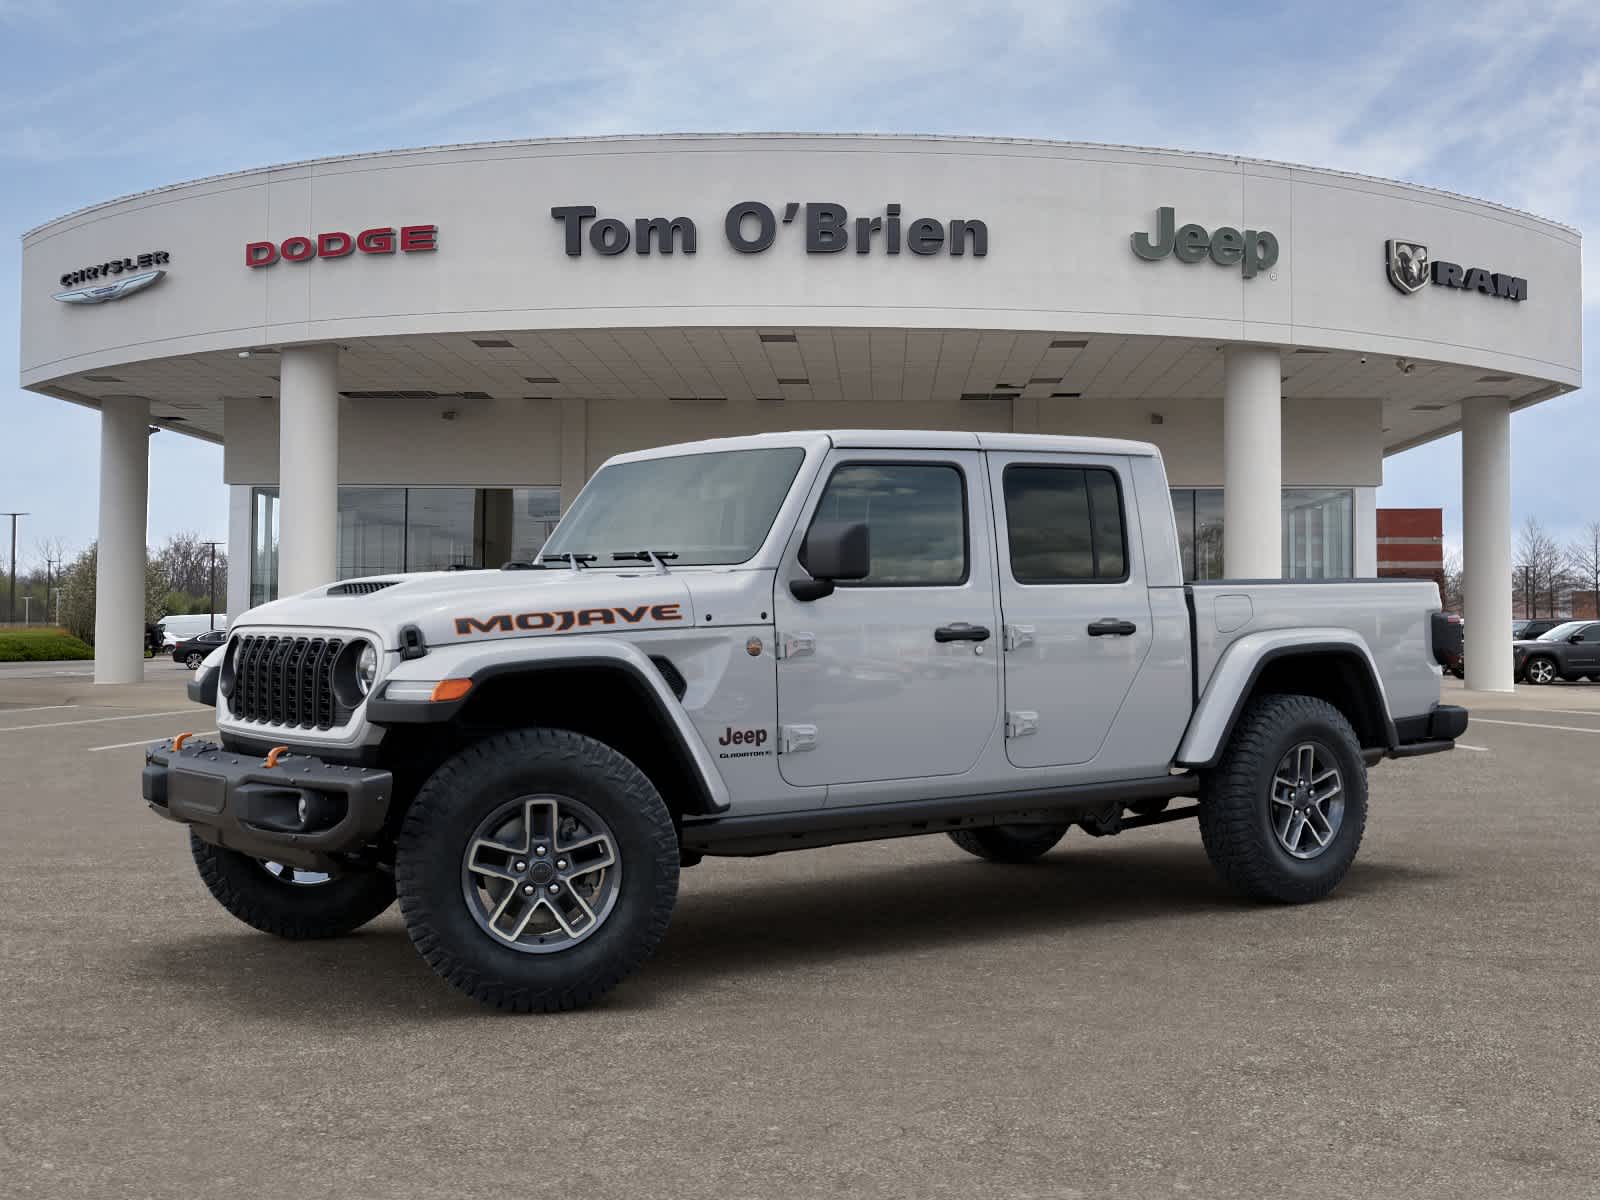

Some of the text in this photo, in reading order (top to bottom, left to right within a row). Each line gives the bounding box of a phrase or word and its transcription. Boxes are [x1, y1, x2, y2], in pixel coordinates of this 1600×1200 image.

[246, 225, 437, 268] DODGE
[551, 201, 988, 257] Tom O'Brien
[1131, 207, 1279, 279] Jeep
[60, 249, 169, 287] CHRYSLER
[1431, 261, 1527, 302] RAM
[454, 603, 682, 635] MOJAVE
[719, 727, 767, 747] Jeep
